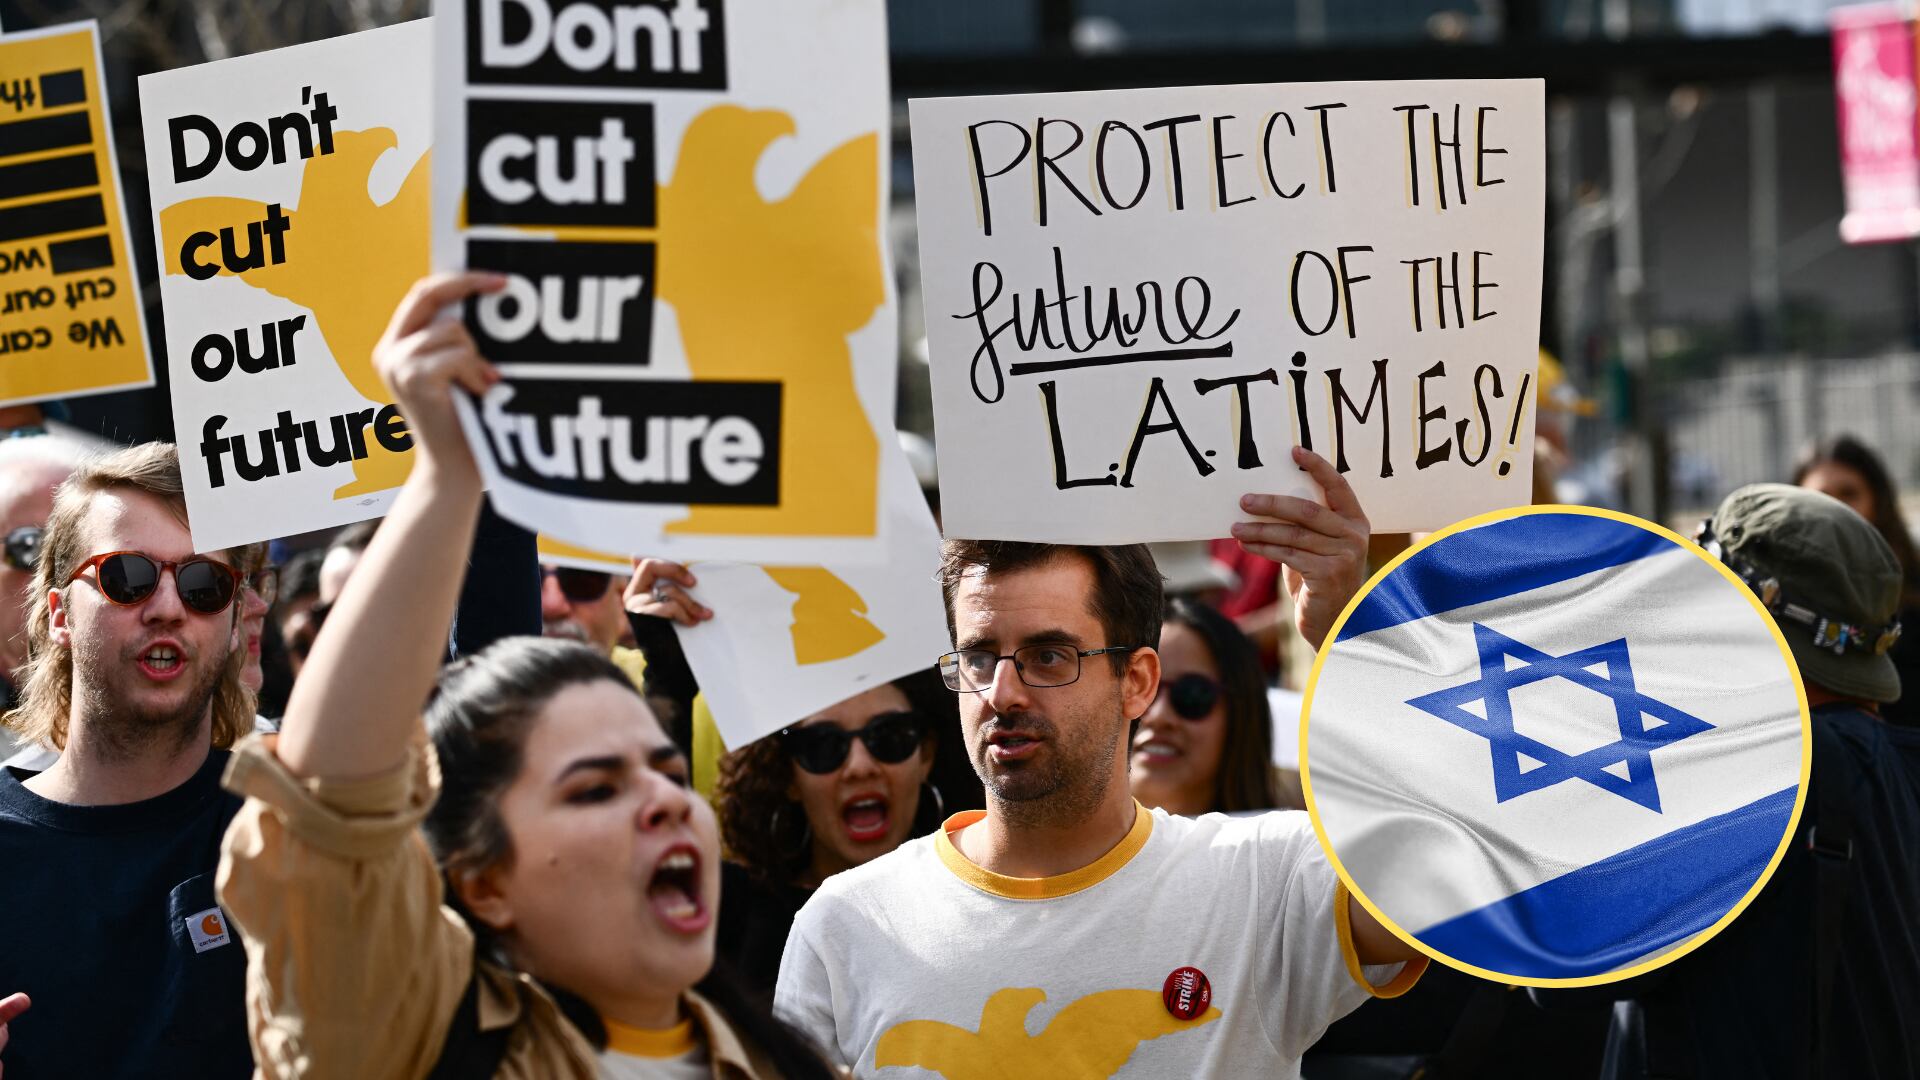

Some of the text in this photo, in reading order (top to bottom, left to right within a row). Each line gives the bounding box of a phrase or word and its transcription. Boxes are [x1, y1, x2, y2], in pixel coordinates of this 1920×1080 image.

[480, 0, 710, 72] Dont
[168, 86, 338, 184] Don't
[479, 119, 634, 204] cut
[966, 102, 1509, 237] PROTECT THE
[180, 203, 291, 281] cut
[1, 277, 116, 315] cut our
[67, 316, 125, 351] We
[477, 274, 643, 343] our
[952, 246, 1499, 404] future OF THE
[191, 315, 307, 382] our
[200, 403, 416, 488] future
[483, 384, 764, 485] future
[1178, 970, 1195, 1011] STRIKE
